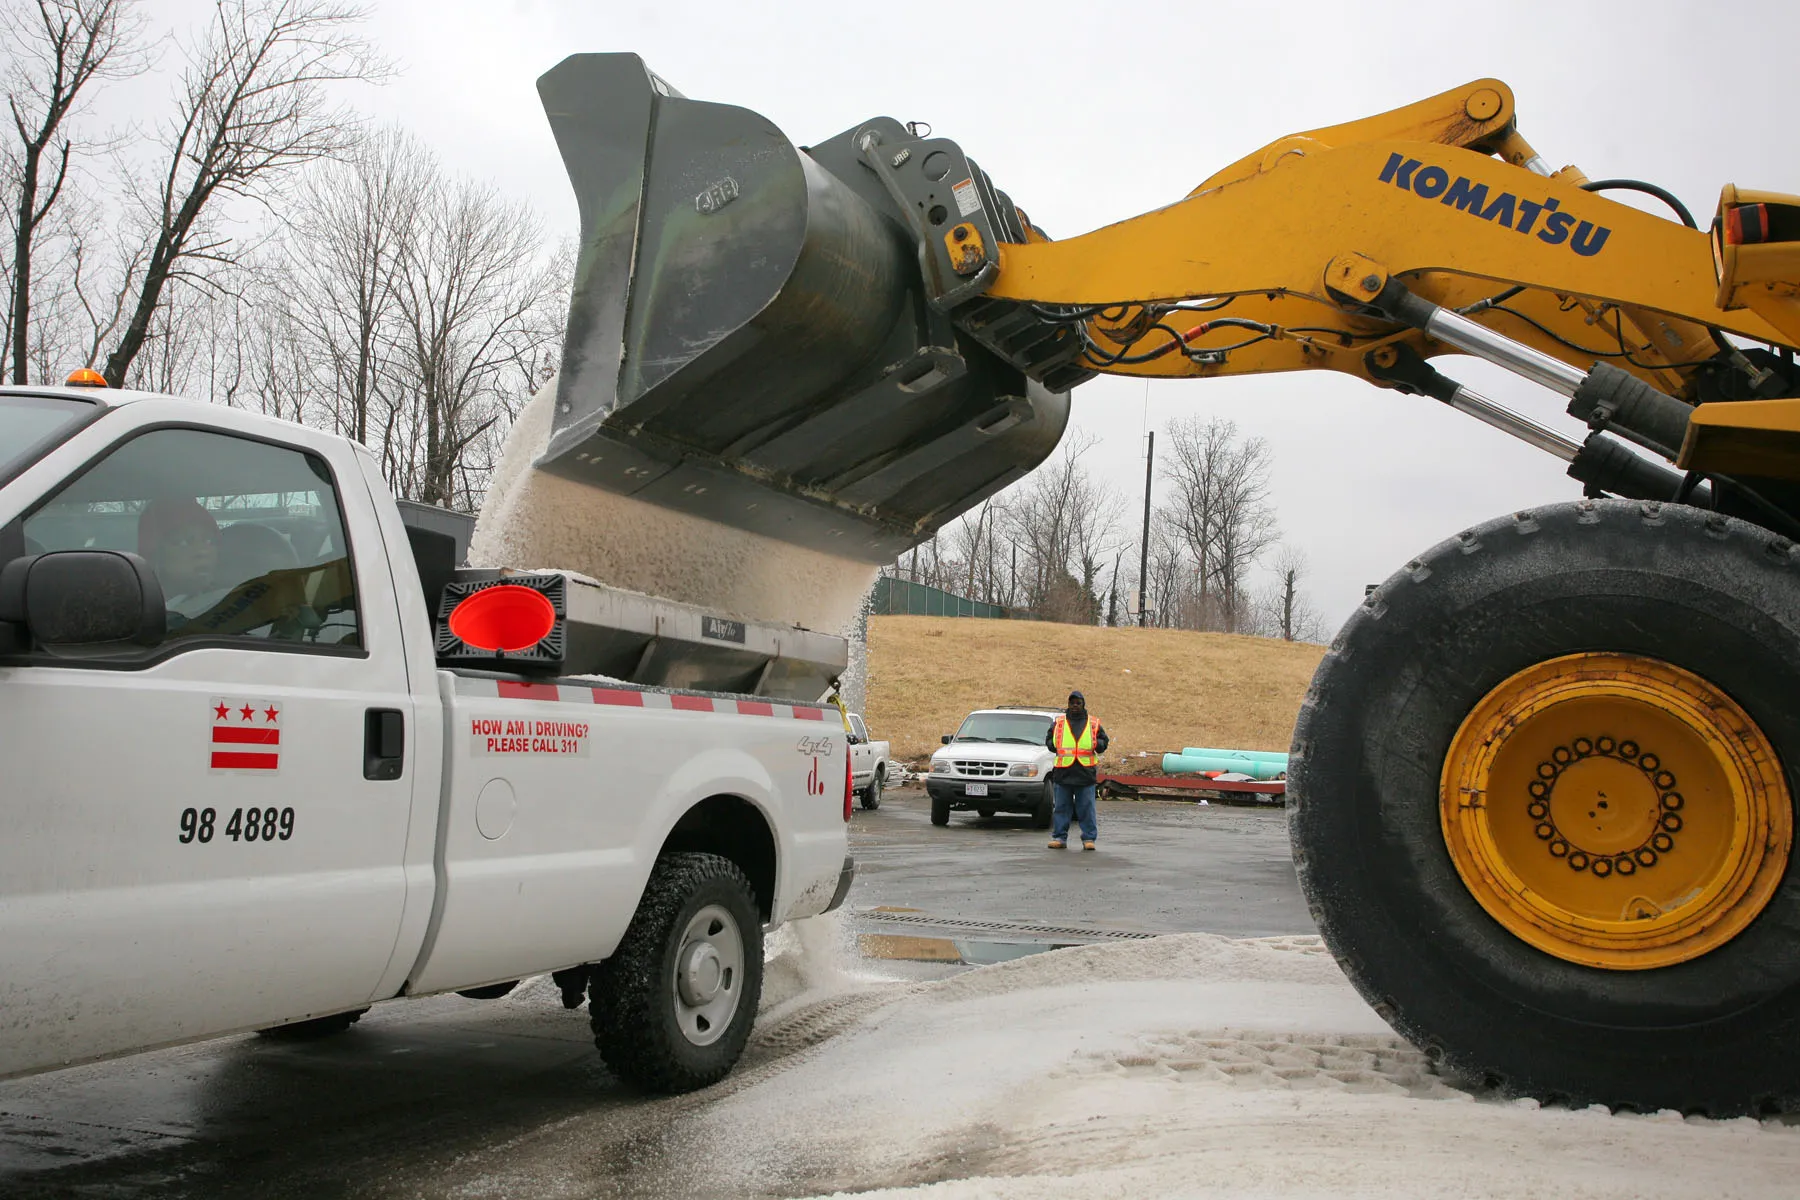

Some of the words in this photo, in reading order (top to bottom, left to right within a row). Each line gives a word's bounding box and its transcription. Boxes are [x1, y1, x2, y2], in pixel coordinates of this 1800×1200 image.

[894, 148, 911, 166] JRB
[1378, 152, 1612, 256] KOMATSU
[472, 720, 502, 735] HOW
[506, 720, 525, 735] AM
[528, 721, 533, 736] I
[536, 721, 589, 738] DRIVING?
[487, 738, 529, 753] PLEASE
[532, 739, 558, 753] CALL
[561, 739, 578, 753] 311
[797, 735, 832, 756] 4x4
[179, 807, 217, 844] 98
[225, 806, 295, 842] 4889
